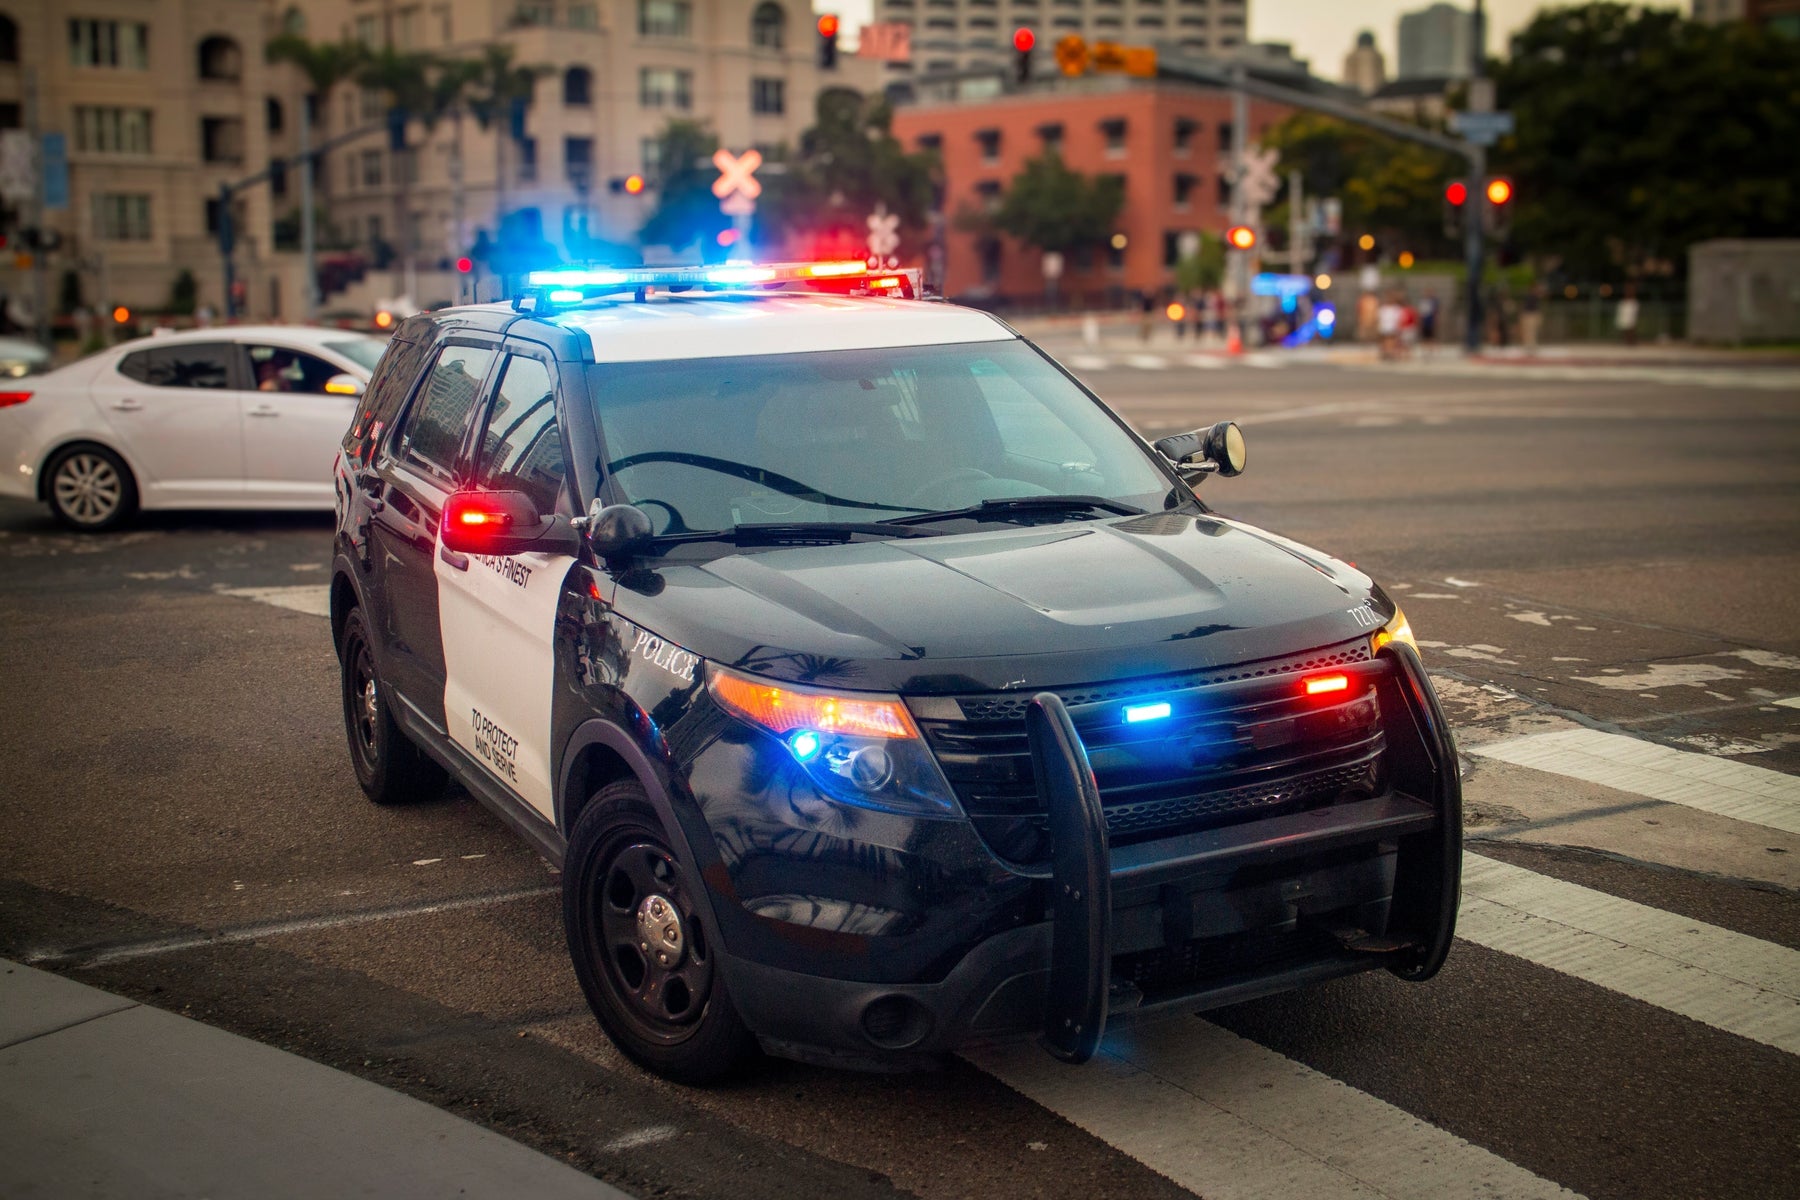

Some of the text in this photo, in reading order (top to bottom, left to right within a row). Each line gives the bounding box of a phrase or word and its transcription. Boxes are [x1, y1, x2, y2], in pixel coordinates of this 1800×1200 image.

[502, 556, 532, 588] FINEST
[631, 631, 699, 681] POLICE
[472, 707, 519, 760] TO PROTECT
[475, 734, 518, 783] AND SERVE
